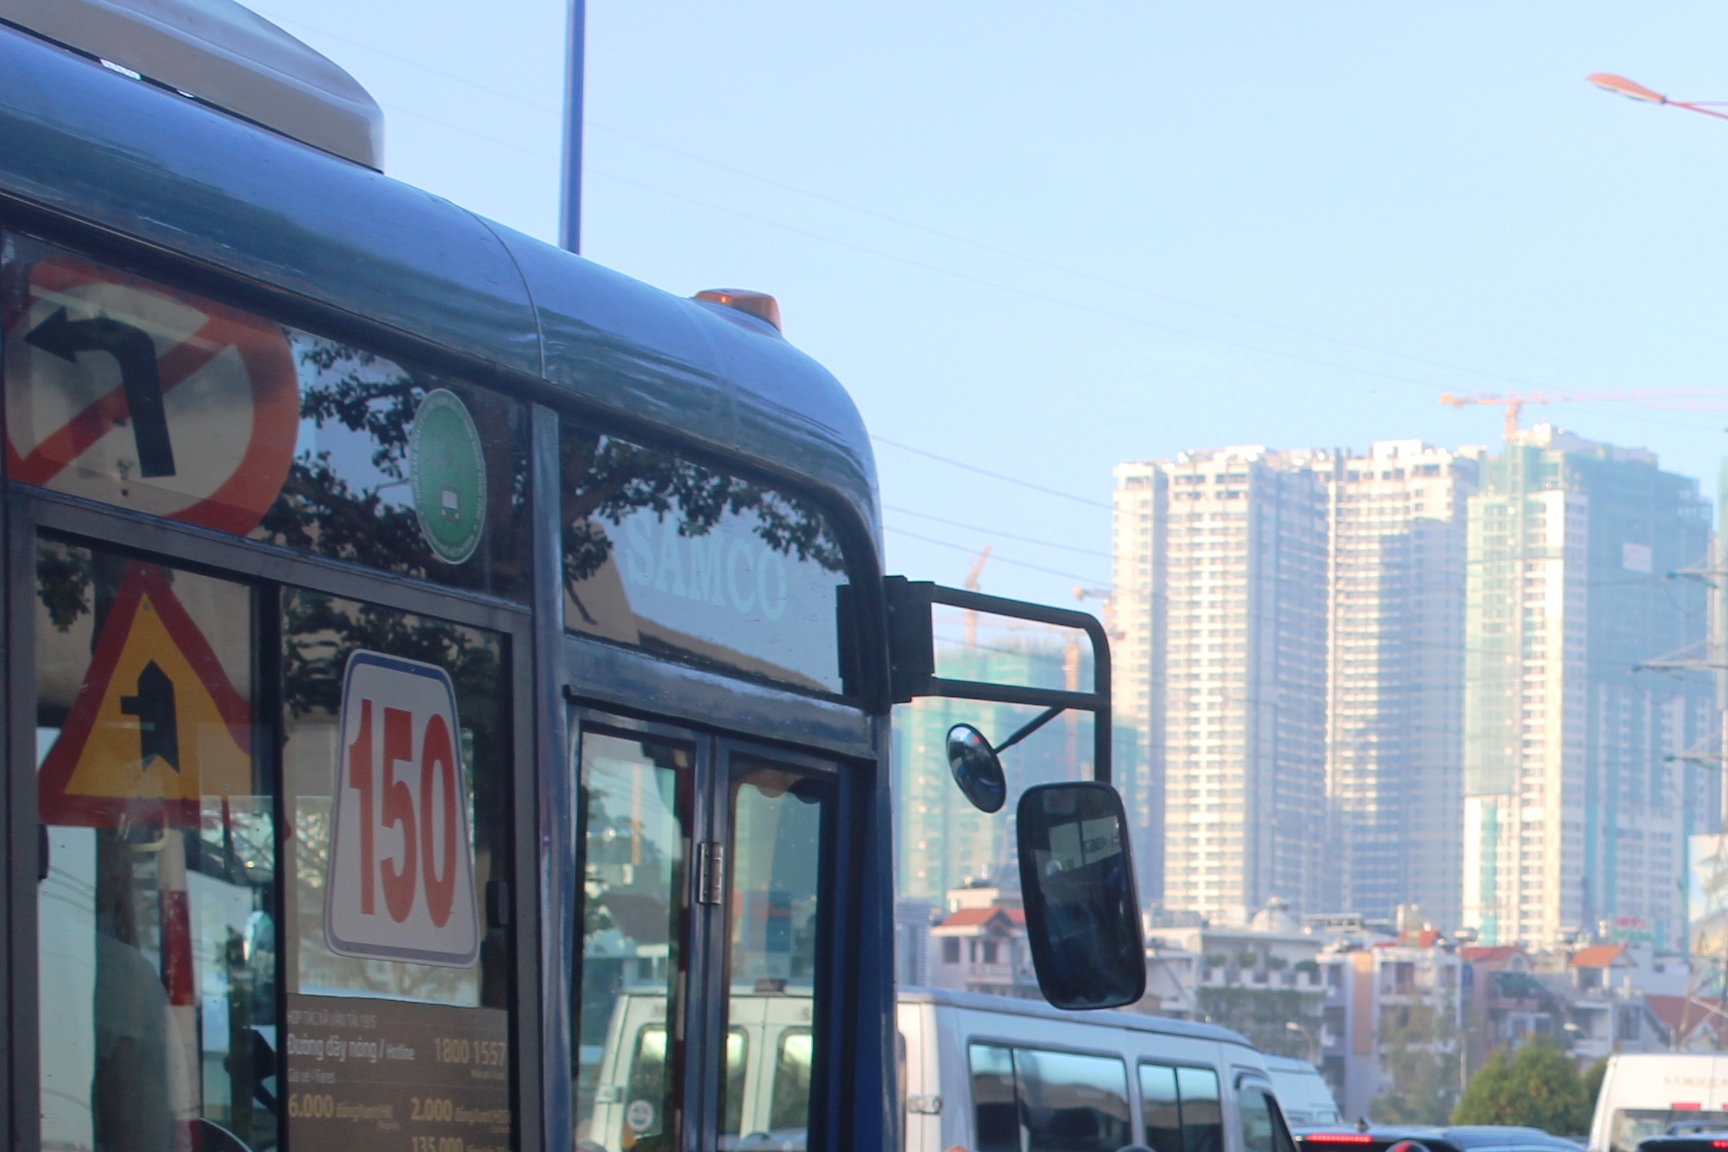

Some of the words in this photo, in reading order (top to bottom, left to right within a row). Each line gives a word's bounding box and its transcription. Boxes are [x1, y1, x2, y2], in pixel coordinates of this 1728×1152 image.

[627, 514, 787, 620] SAMCO
[350, 698, 457, 928] 150
[434, 1037, 469, 1064] 1800
[472, 1039, 508, 1066] 1557
[288, 1093, 334, 1119] 6.000
[411, 1097, 453, 1122] 2.000
